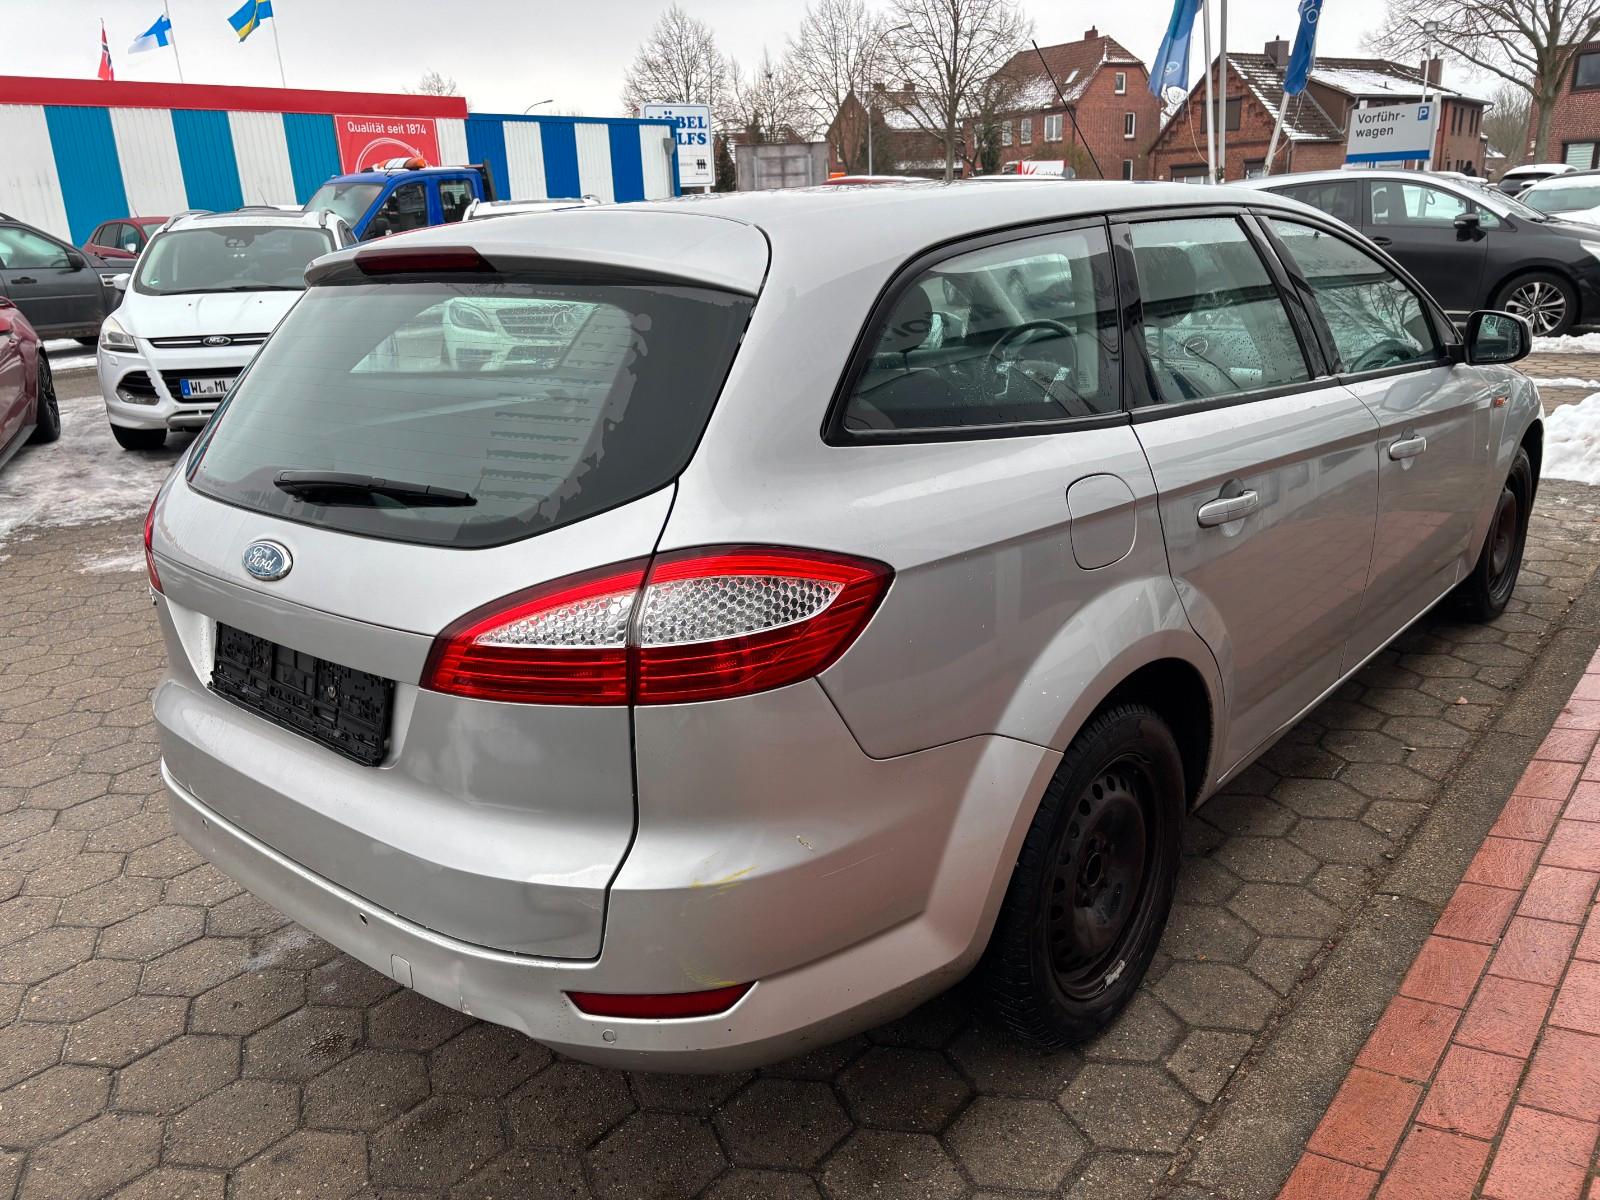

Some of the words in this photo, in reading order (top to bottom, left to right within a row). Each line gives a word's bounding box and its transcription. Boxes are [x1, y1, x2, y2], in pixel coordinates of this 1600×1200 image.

[647, 110, 707, 129] BEL
[1358, 111, 1406, 124] Vorführ-
[1419, 107, 1428, 119] P
[347, 121, 385, 134] Qualität
[387, 123, 405, 134] seit
[406, 123, 427, 135] 1874
[1355, 126, 1394, 139] wagen
[677, 132, 707, 145] LFS
[190, 381, 207, 394] WL
[249, 546, 277, 571] Ford
